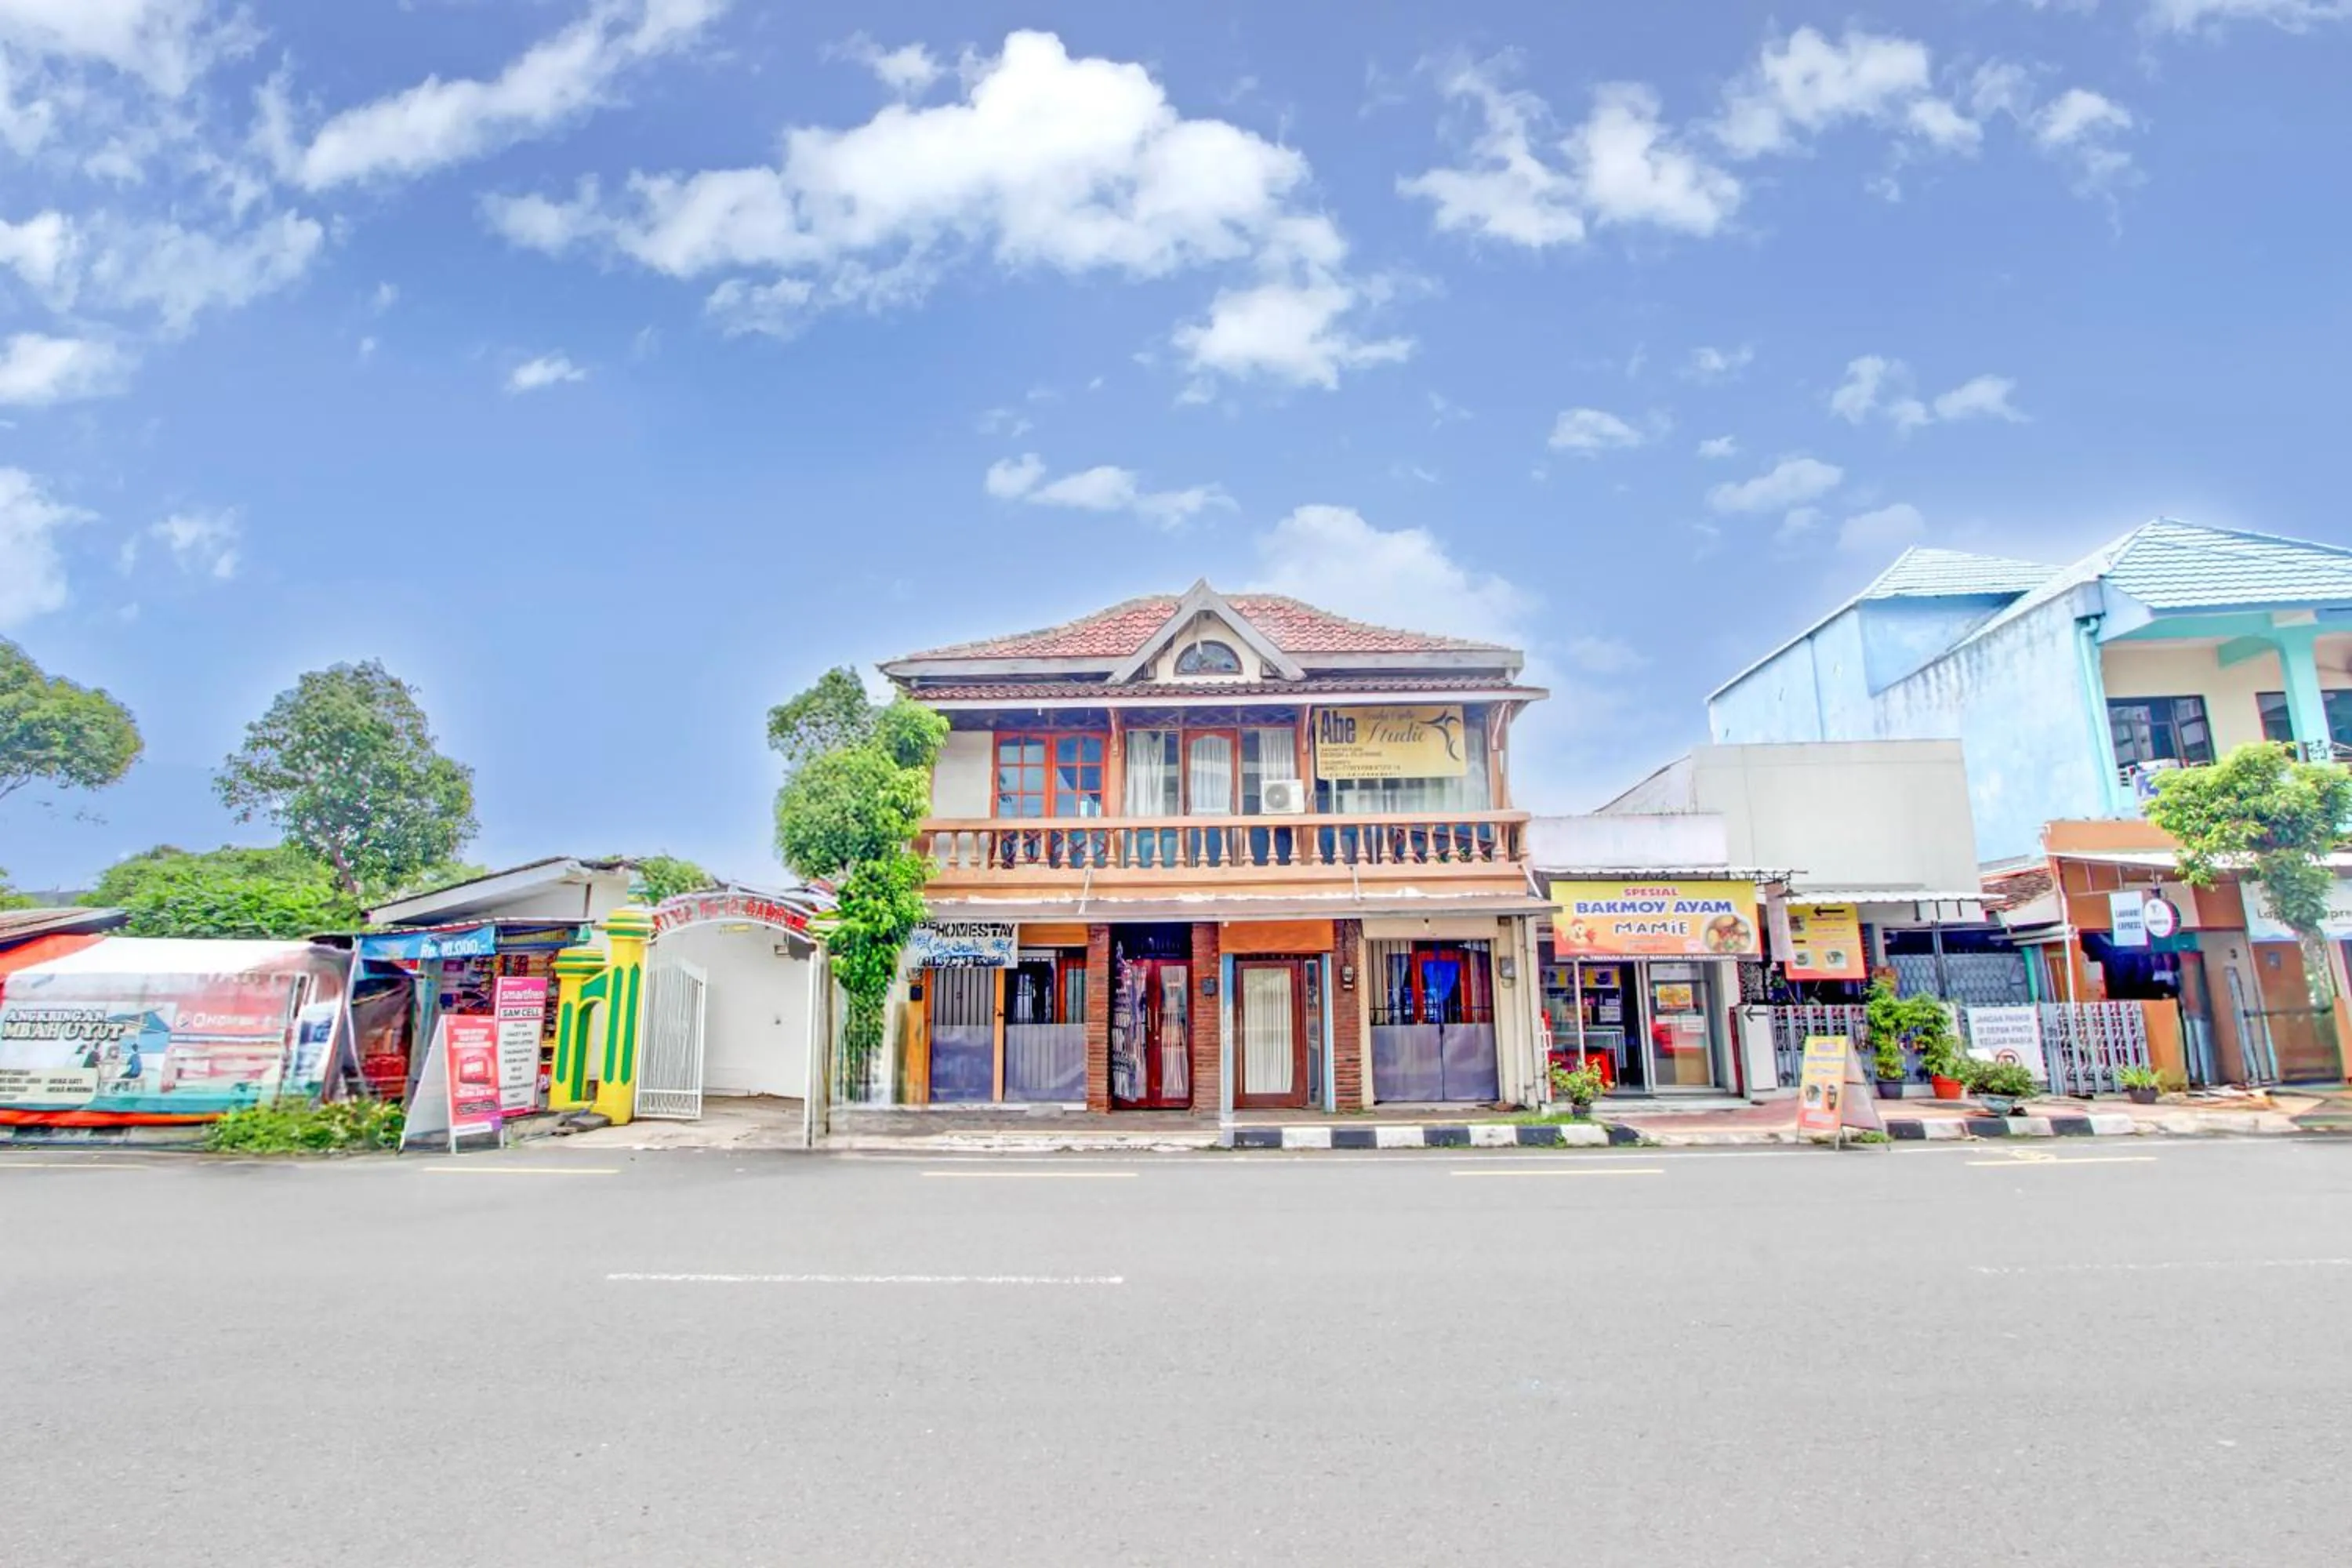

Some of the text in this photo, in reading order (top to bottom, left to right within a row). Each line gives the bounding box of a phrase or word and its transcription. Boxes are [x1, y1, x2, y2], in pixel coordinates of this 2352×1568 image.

[1320, 710, 1356, 744] Abe
[1367, 719, 1428, 743] Studio
[1624, 888, 1679, 897] SPESIAL
[1576, 901, 1733, 913] BAKMOY AYAM
[935, 922, 1014, 938] HOMESTAY
[4, 1008, 106, 1023] ANGKRINGAN
[521, 1007, 540, 1017] CELL
[2, 1022, 125, 1042] MBAH UYUT
